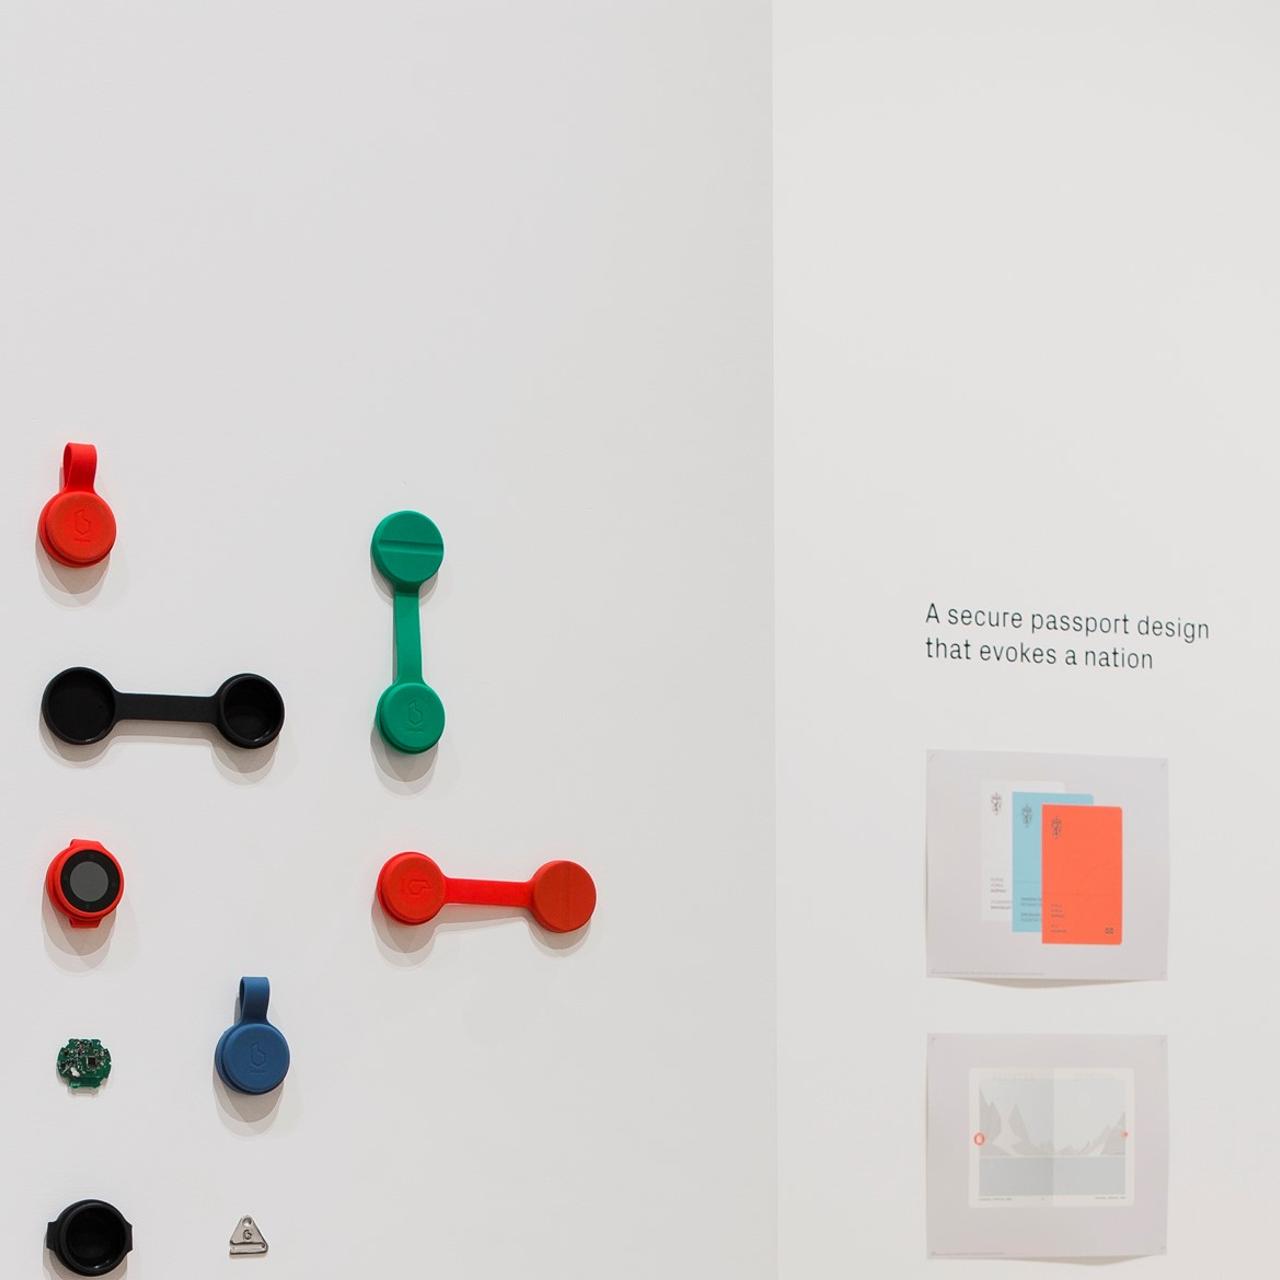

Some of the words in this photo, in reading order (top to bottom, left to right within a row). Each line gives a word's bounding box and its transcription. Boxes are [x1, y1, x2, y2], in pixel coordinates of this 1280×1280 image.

[926, 603, 940, 624] A
[948, 607, 1023, 629] secure
[1031, 612, 1129, 637] passport
[1137, 616, 1210, 644] design
[926, 637, 972, 661] that
[979, 642, 1057, 665] evokes
[1064, 648, 1077, 666] a
[1084, 647, 1153, 669] nation
